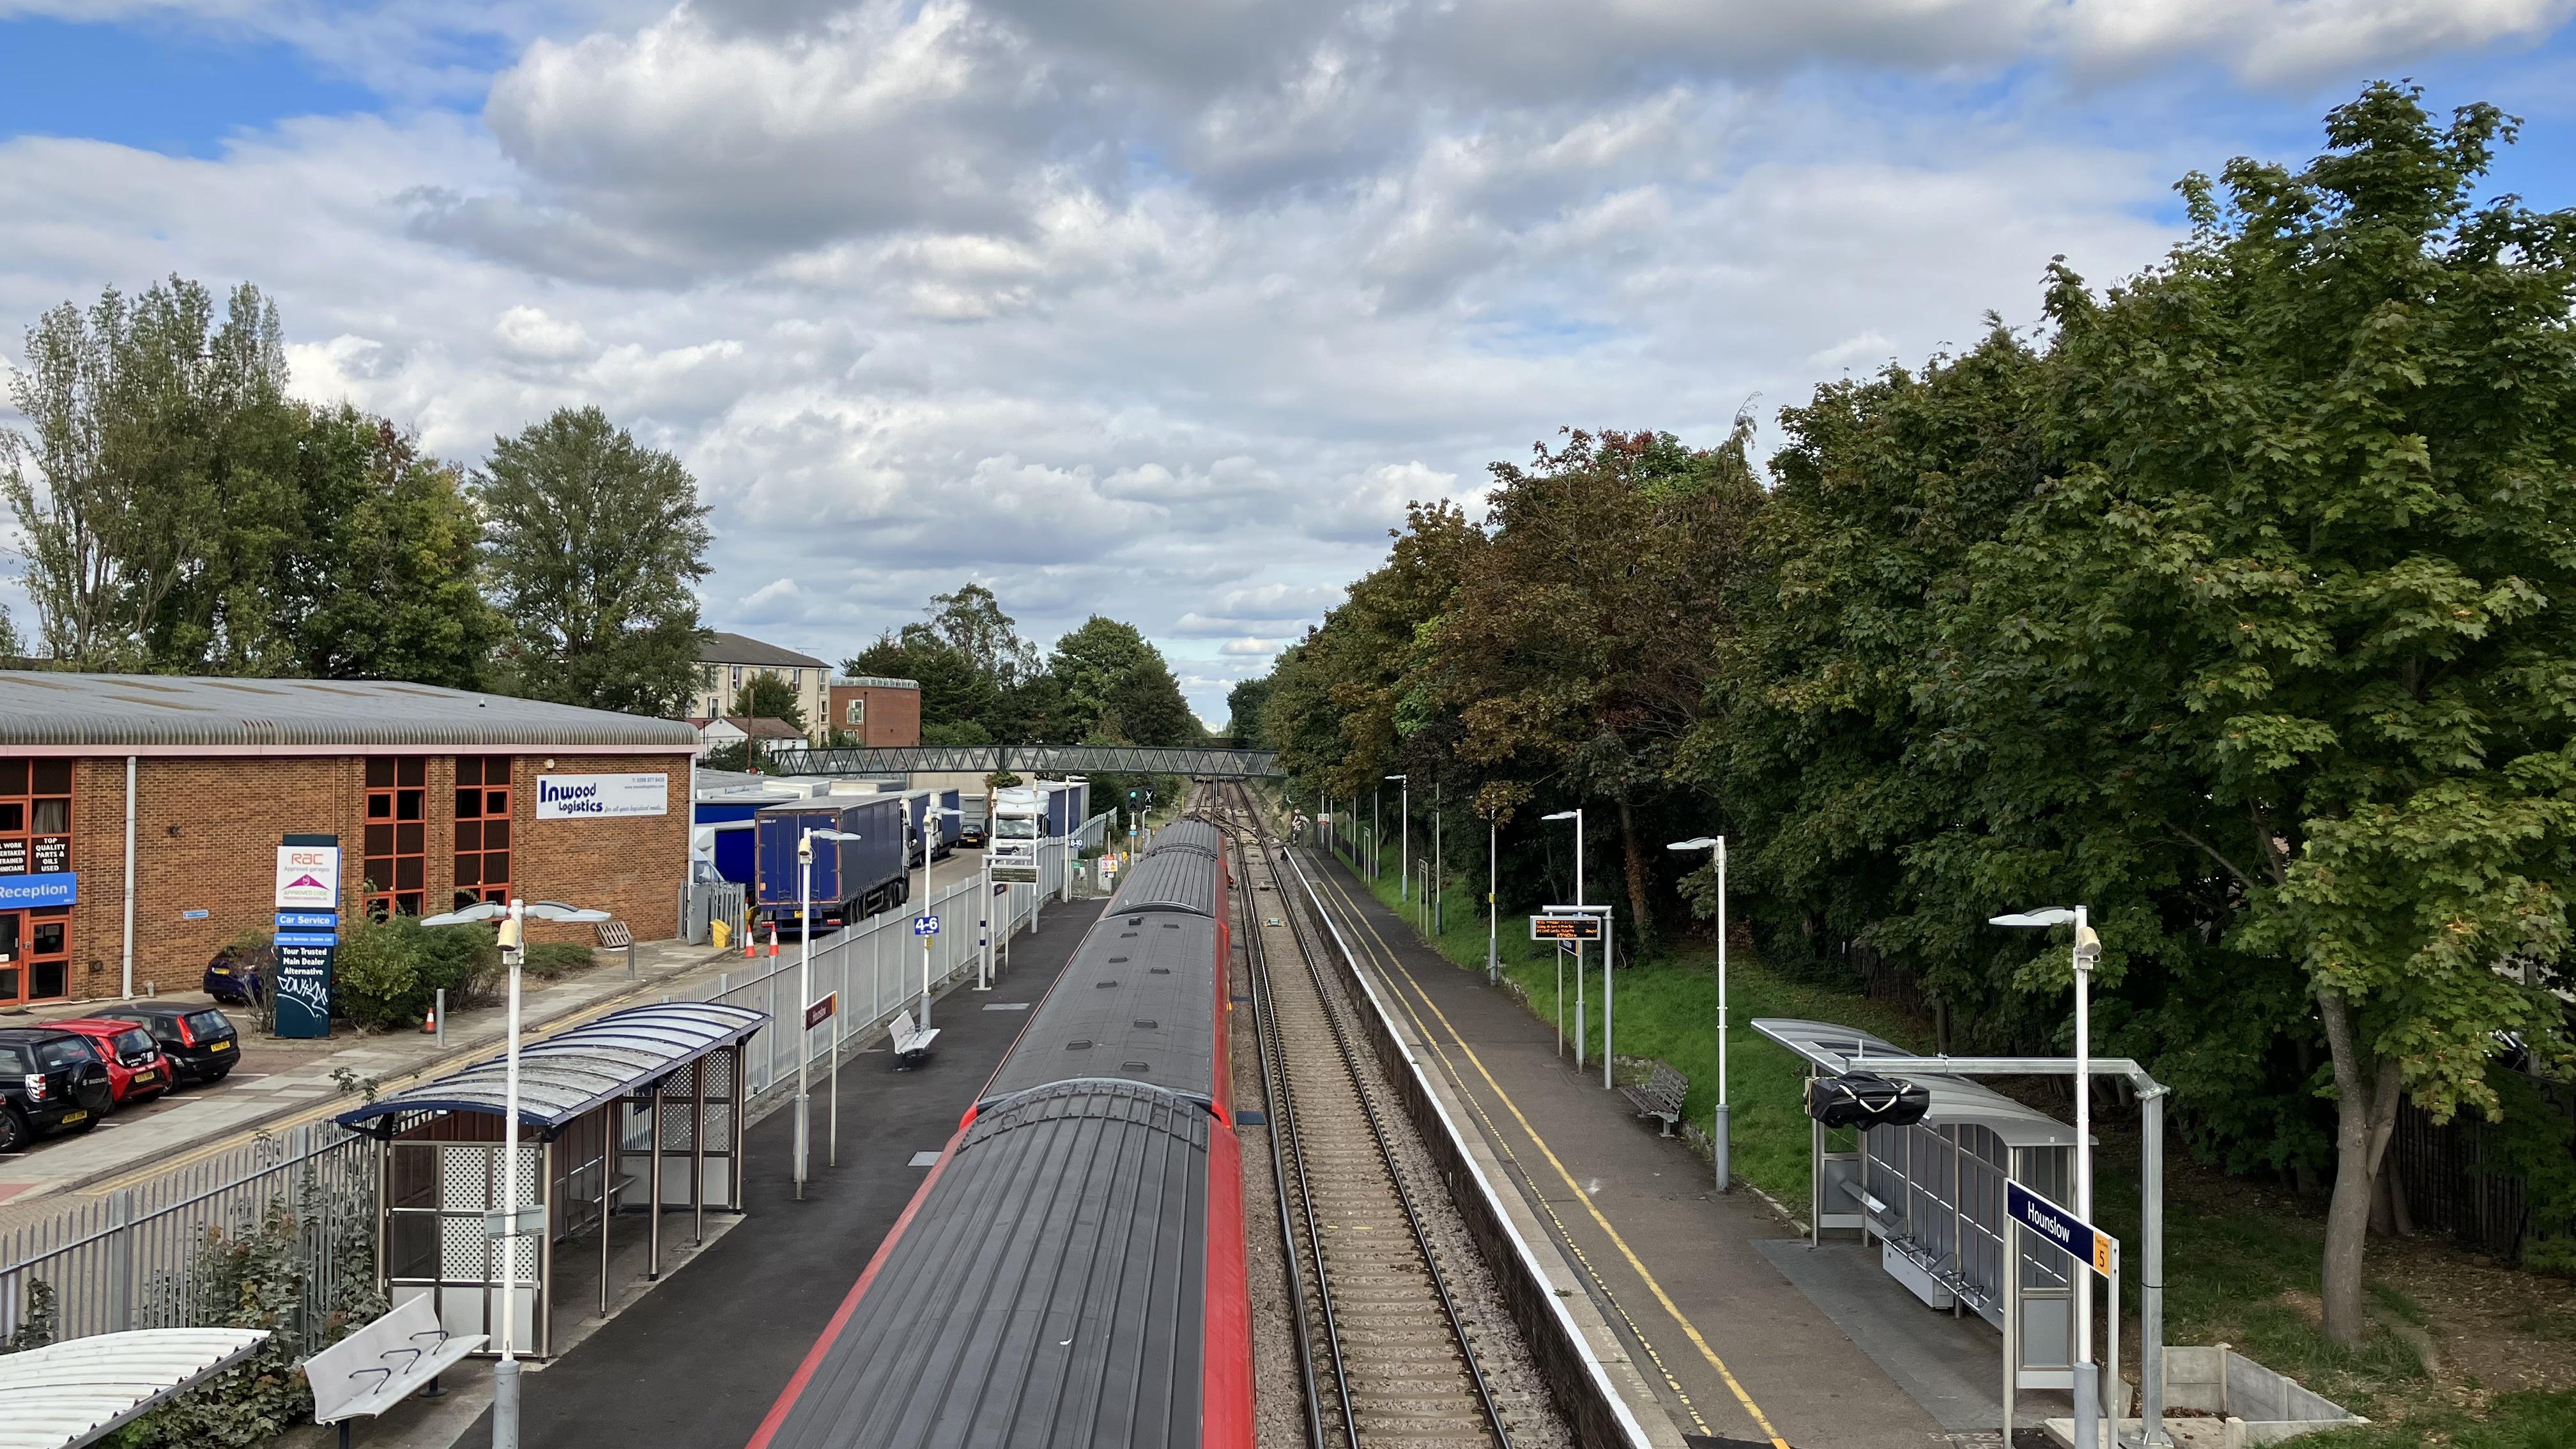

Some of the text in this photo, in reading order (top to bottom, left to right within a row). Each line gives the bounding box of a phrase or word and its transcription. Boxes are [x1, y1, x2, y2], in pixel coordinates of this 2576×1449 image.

[540, 780, 596, 803] Inwood
[558, 799, 603, 814] Logistics
[279, 916, 330, 924] Car Service
[915, 917, 938, 931] 4-6
[282, 947, 328, 956] Your Trusted
[283, 957, 325, 965] Main Dealer
[284, 967, 324, 976] Alternative
[2027, 1200, 2070, 1243] Hounslow
[2099, 1250, 2105, 1268] 5
